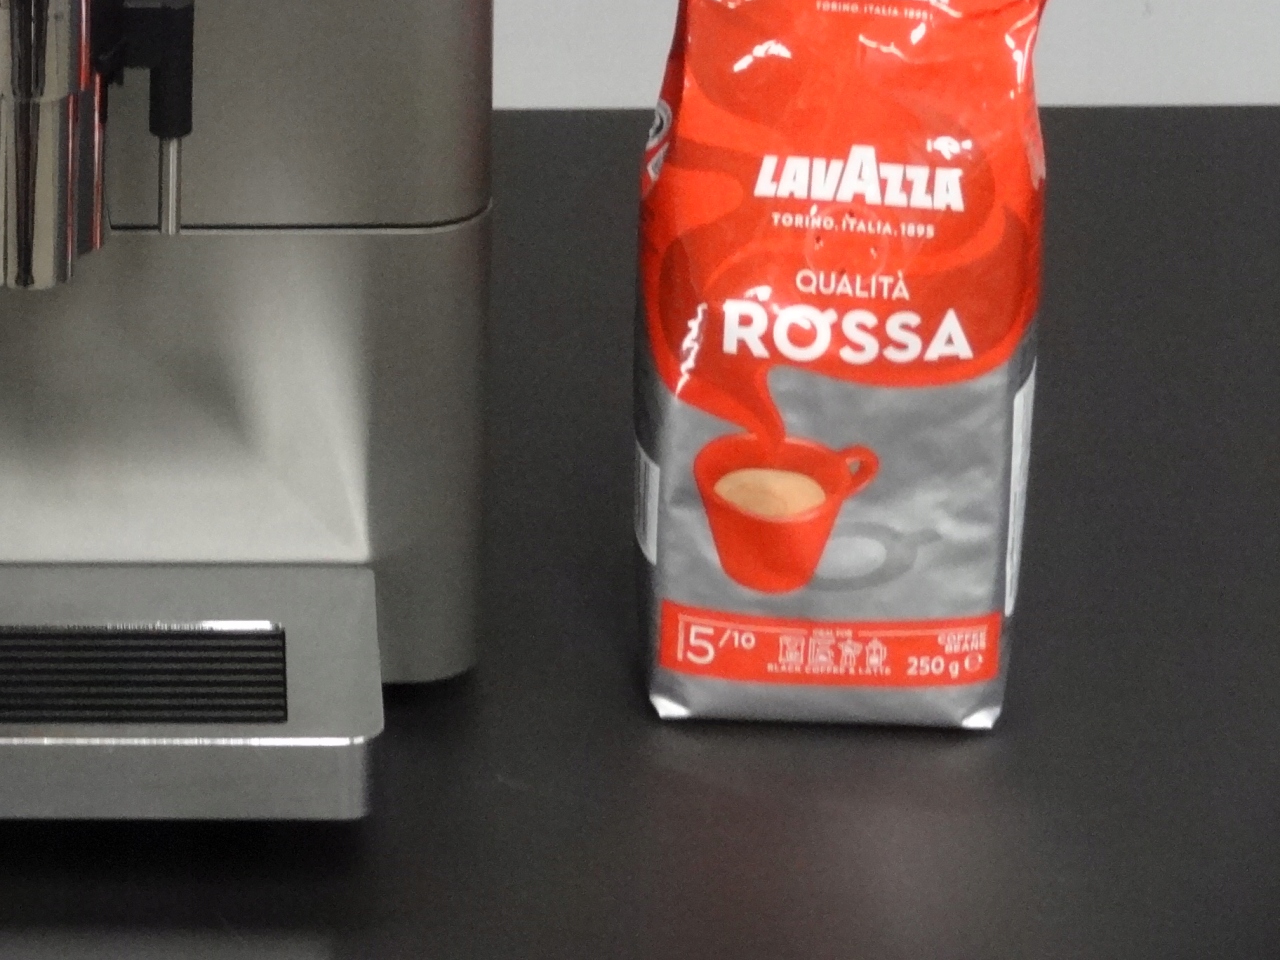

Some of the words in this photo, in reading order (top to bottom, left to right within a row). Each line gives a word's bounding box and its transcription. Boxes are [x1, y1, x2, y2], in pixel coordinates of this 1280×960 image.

[753, 144, 965, 212] LAVAZZA
[900, 221, 936, 239] 1895
[795, 269, 910, 301] QUALITÀ
[722, 298, 974, 365] ROSSA
[906, 655, 945, 676] 250
[948, 660, 960, 679] g
